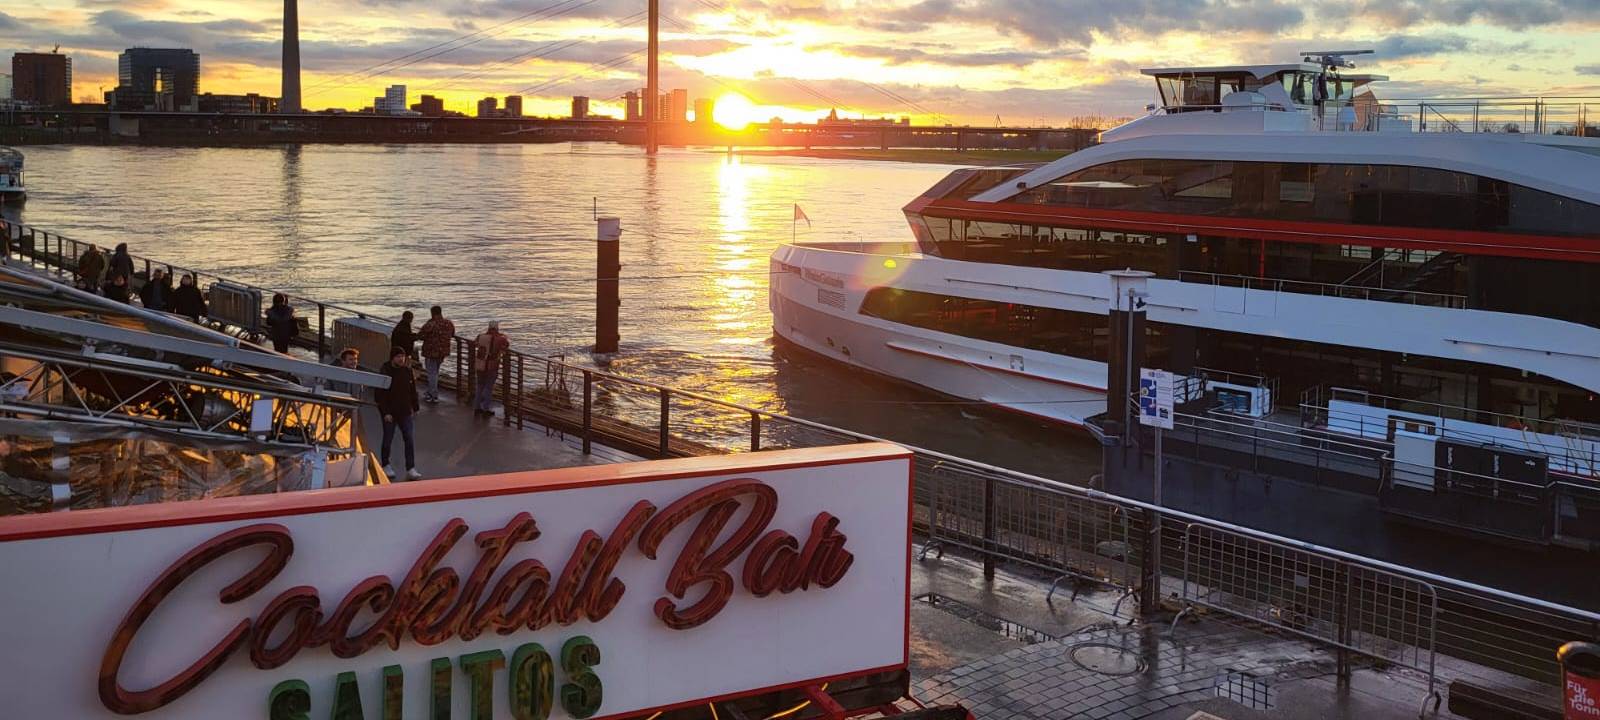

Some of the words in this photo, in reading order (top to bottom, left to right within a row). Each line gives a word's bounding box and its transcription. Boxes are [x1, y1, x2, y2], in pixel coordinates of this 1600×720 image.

[99, 499, 657, 715] Cocktail
[638, 478, 855, 630] Bar
[1567, 680, 1588, 695] Für
[1574, 693, 1596, 706] die
